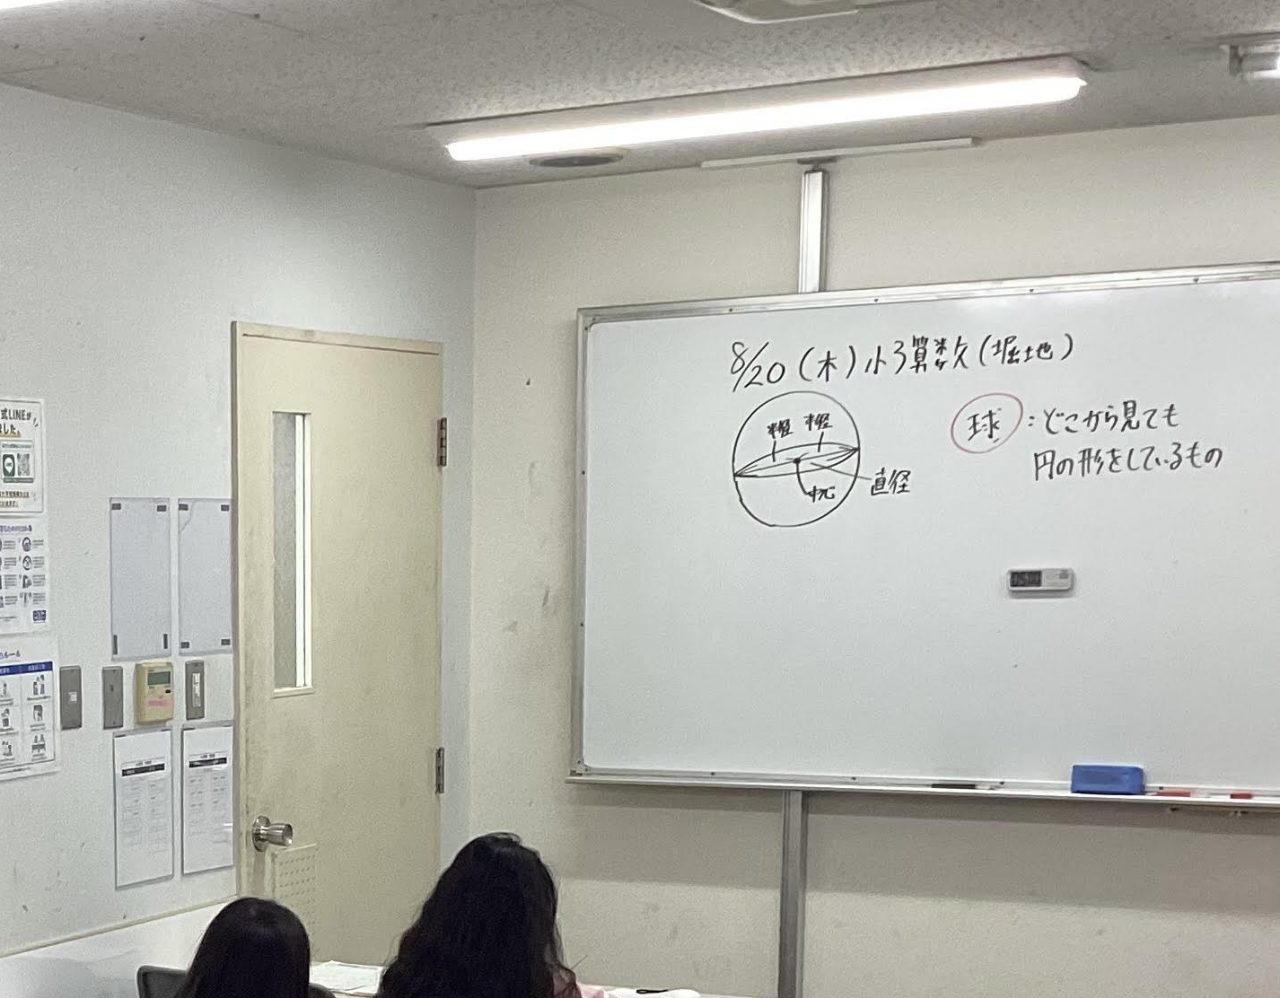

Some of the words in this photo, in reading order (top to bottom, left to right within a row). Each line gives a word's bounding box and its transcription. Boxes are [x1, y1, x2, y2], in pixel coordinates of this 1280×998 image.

[967, 407, 1002, 443] 球
[1034, 441, 1223, 481] 円の形をしているもの
[871, 467, 911, 496] 直径
